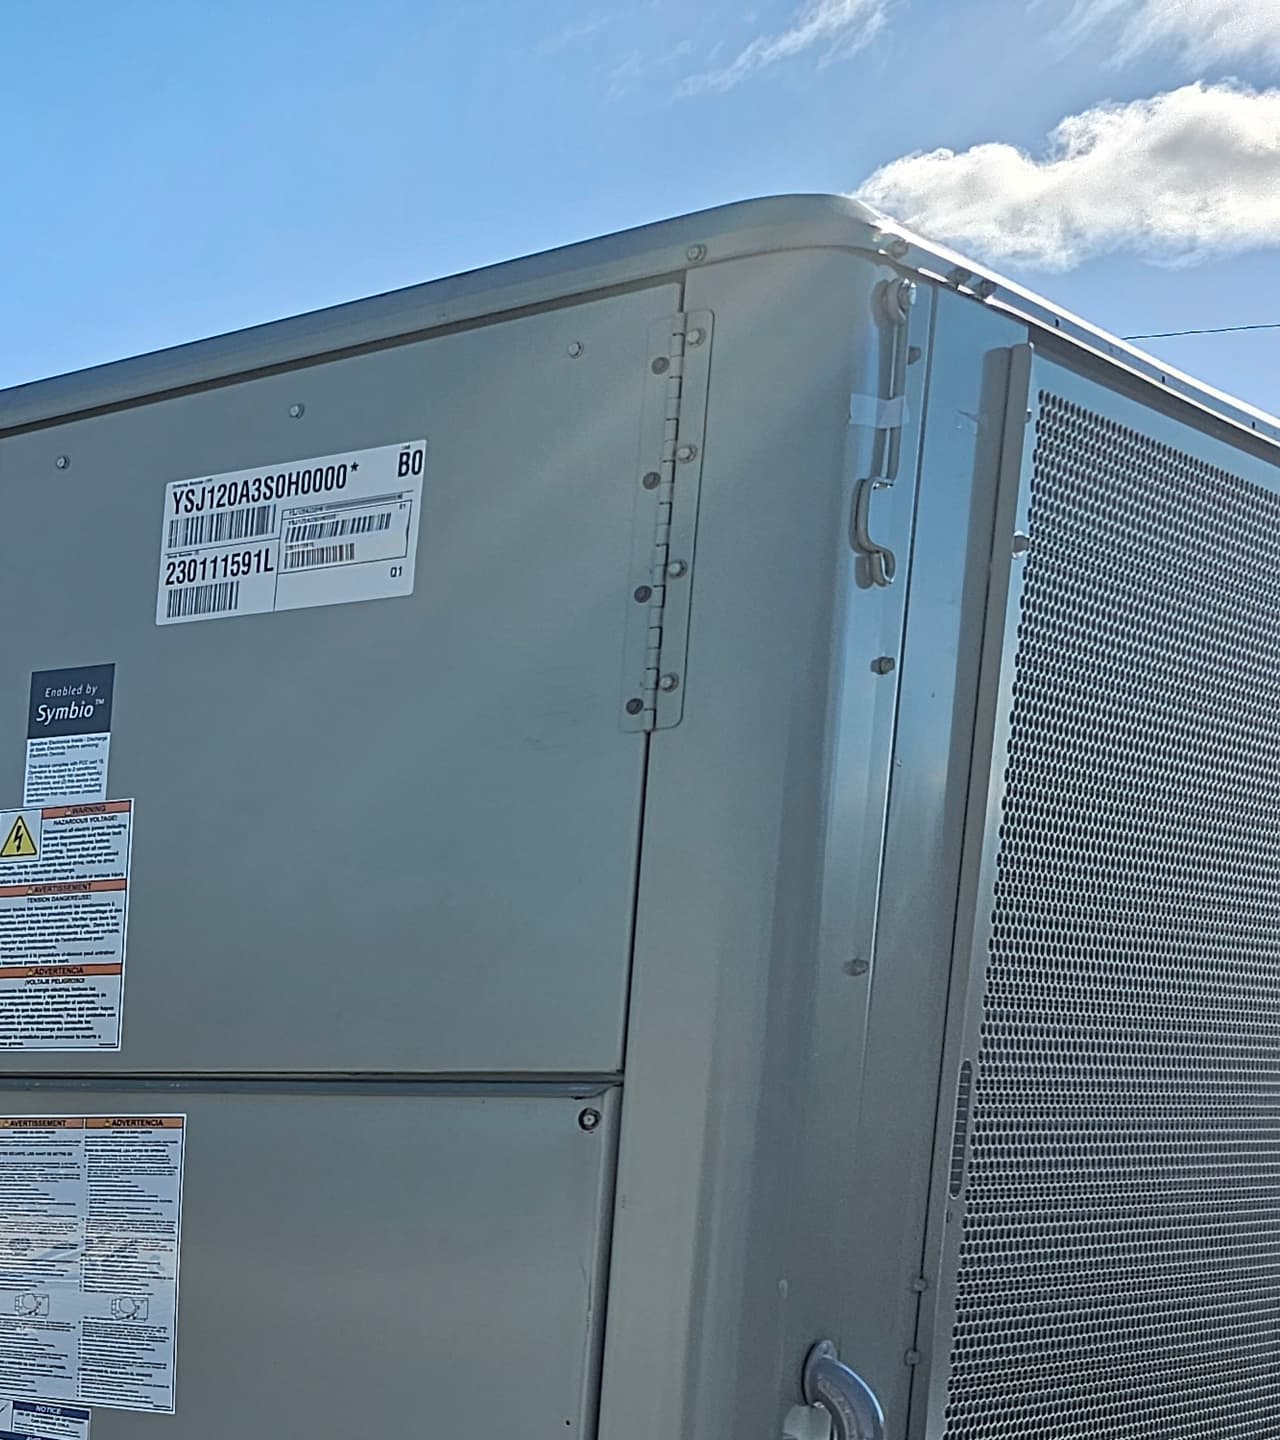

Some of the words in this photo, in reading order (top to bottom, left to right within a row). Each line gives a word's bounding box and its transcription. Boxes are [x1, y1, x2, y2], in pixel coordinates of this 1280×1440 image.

[165, 548, 274, 585] 230111591L
[45, 683, 83, 697] Enabled
[85, 683, 97, 695] by
[34, 967, 84, 976] ADVERTENCIA
[112, 1119, 164, 1127] ADVERTENCIA
[35, 1405, 61, 1414] NOTICE
